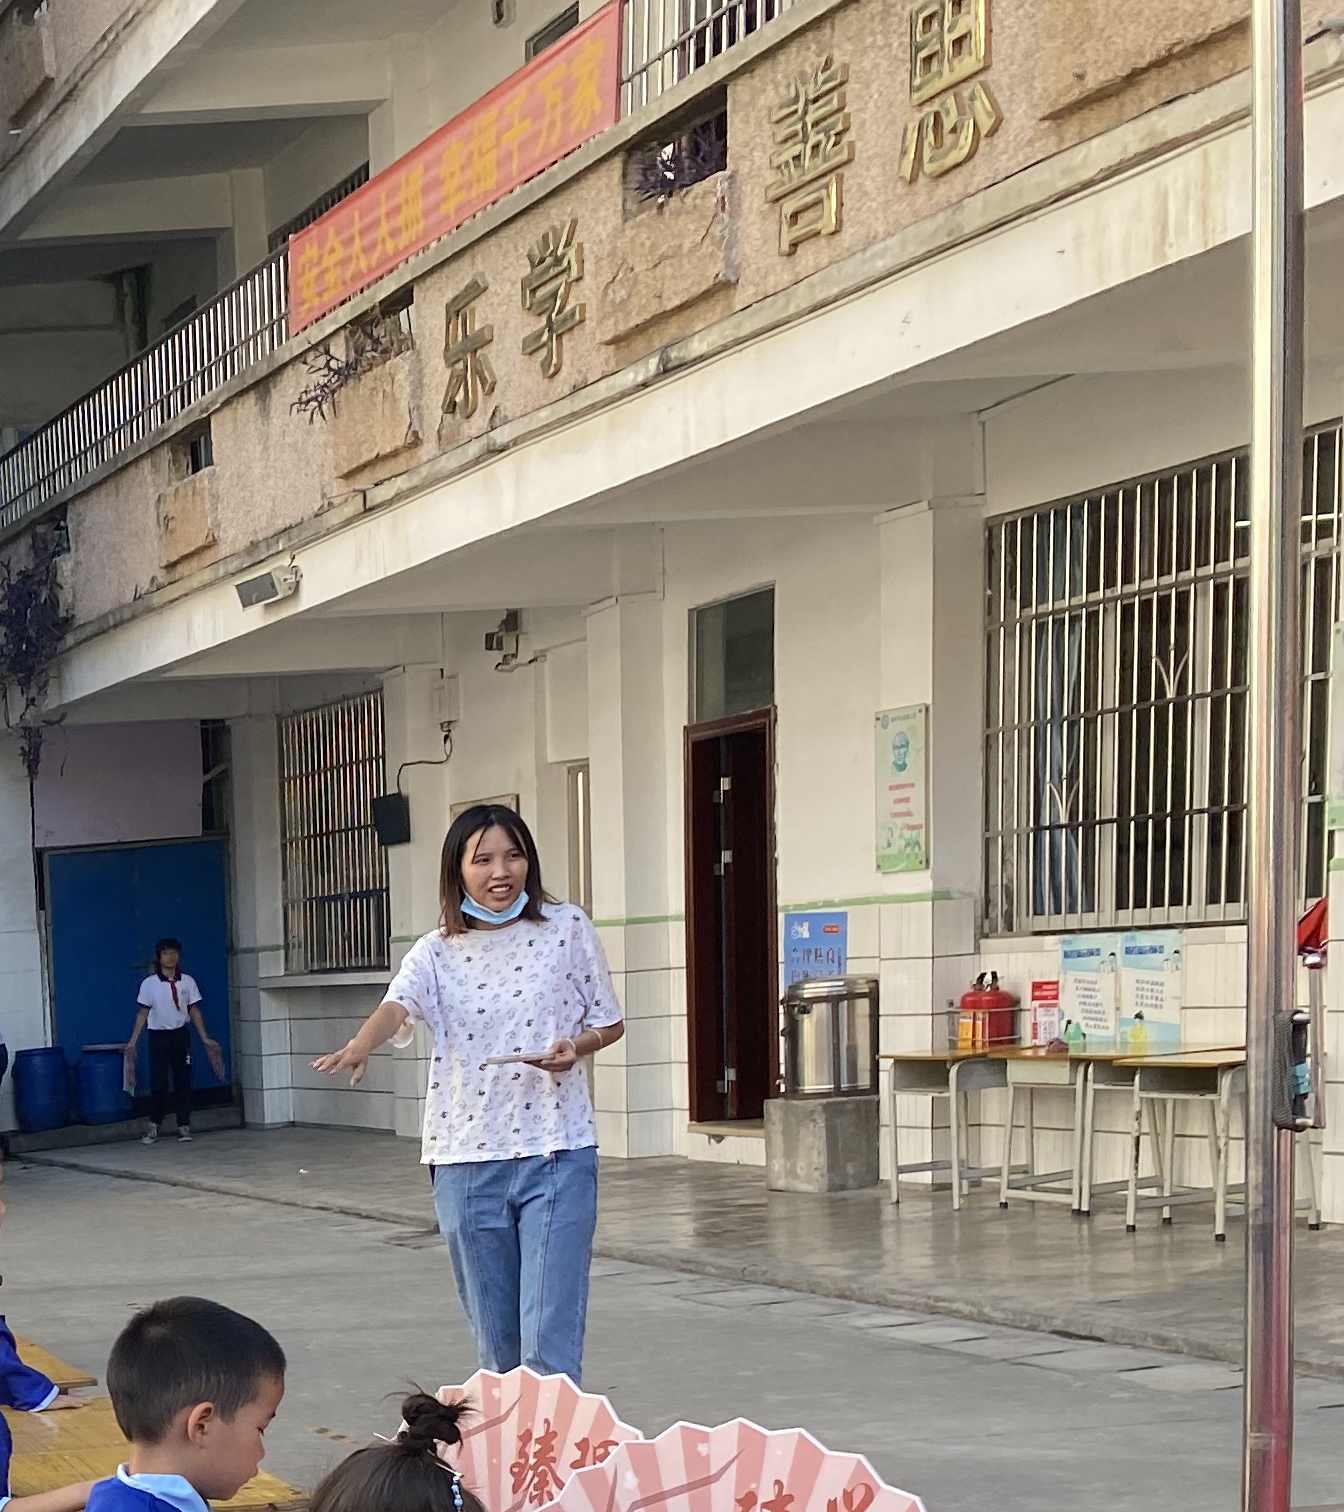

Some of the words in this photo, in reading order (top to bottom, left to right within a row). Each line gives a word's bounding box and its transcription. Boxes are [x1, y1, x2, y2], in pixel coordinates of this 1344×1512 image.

[439, 35, 606, 218] 幸福千万家
